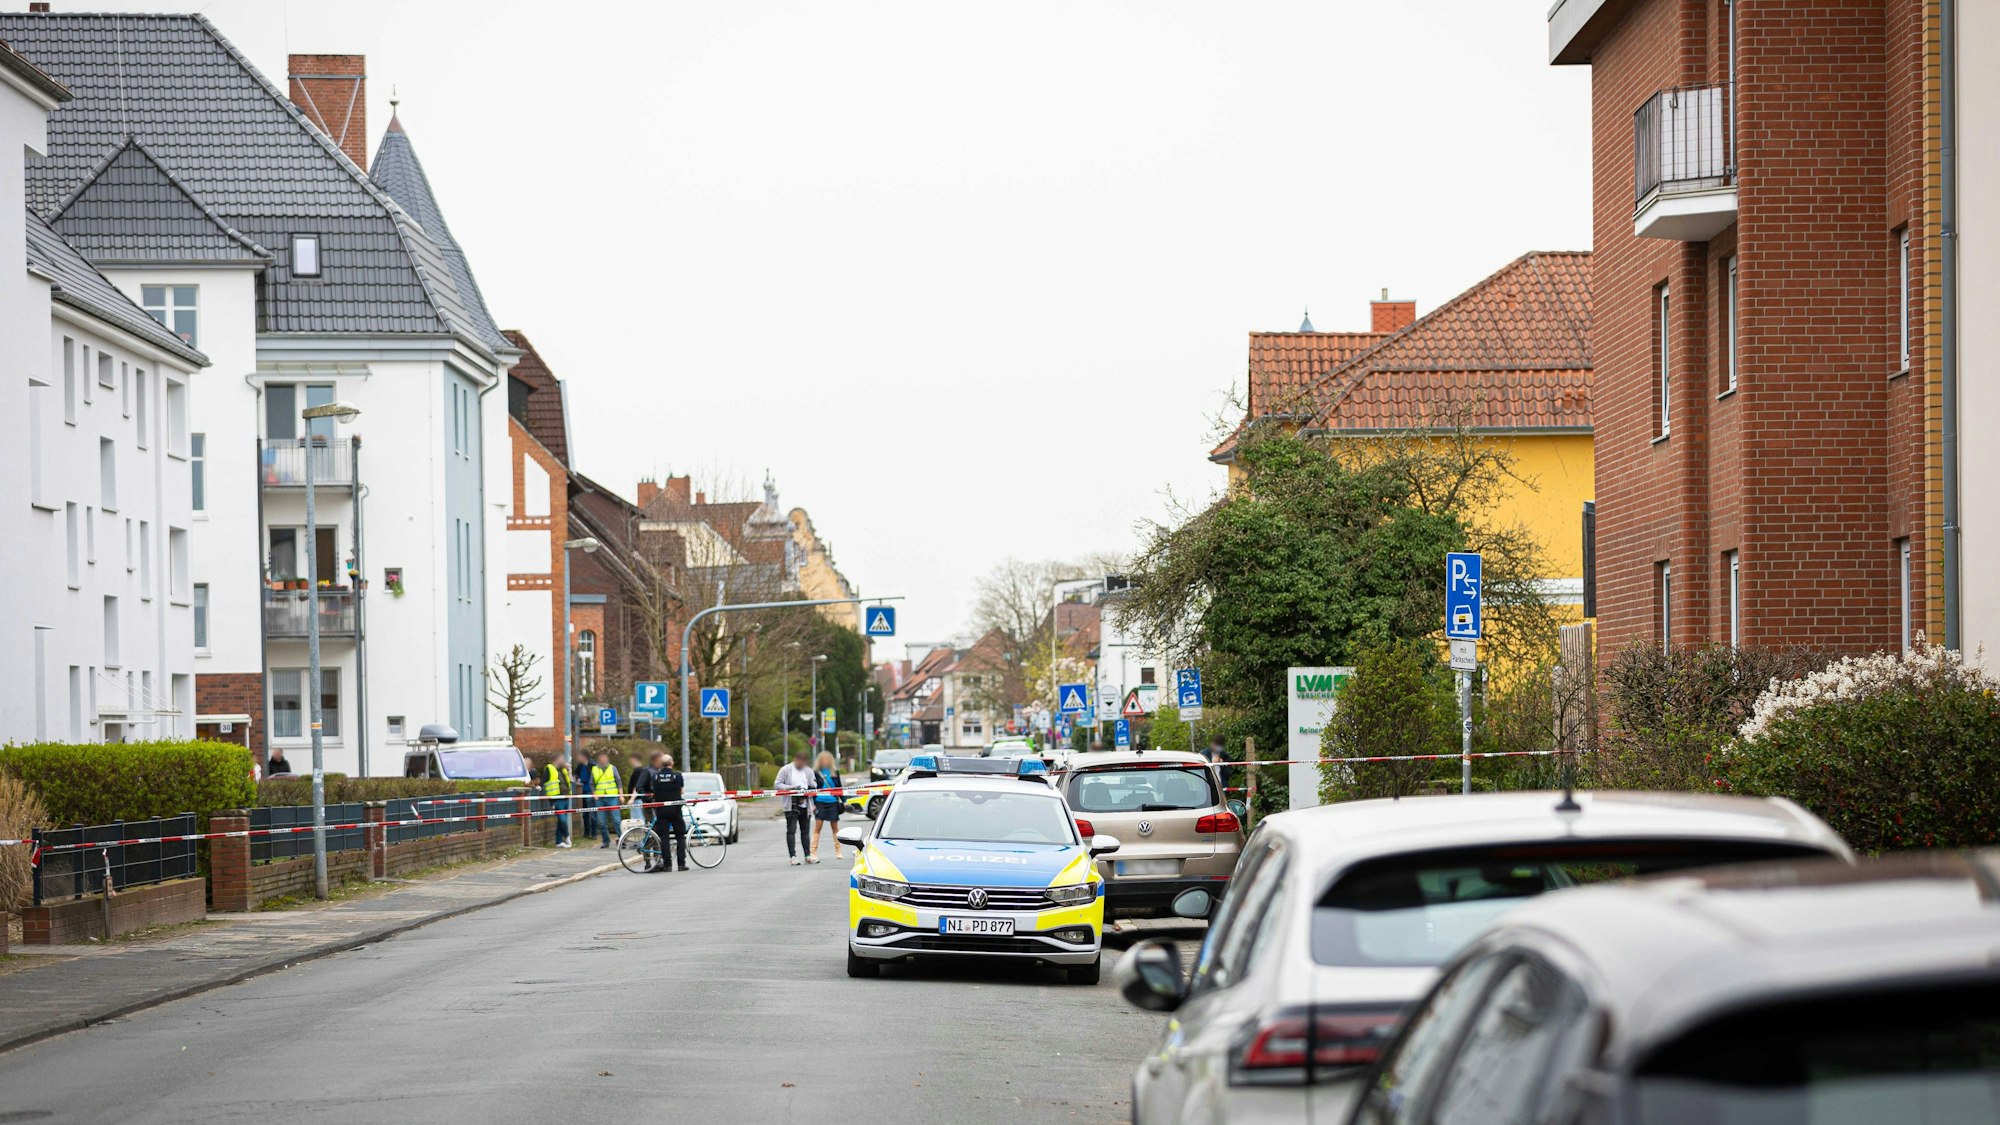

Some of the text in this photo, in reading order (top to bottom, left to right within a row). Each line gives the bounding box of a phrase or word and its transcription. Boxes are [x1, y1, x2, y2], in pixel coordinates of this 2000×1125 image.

[1452, 559, 1467, 592] P
[1296, 674, 1332, 692] LVM
[645, 685, 658, 704] P
[1297, 691, 1338, 699] VERSICHER
[602, 711, 612, 724] P
[1117, 721, 1124, 732] P
[929, 855, 1027, 864] POLIZEI
[948, 919, 1012, 933] NI PD 877
